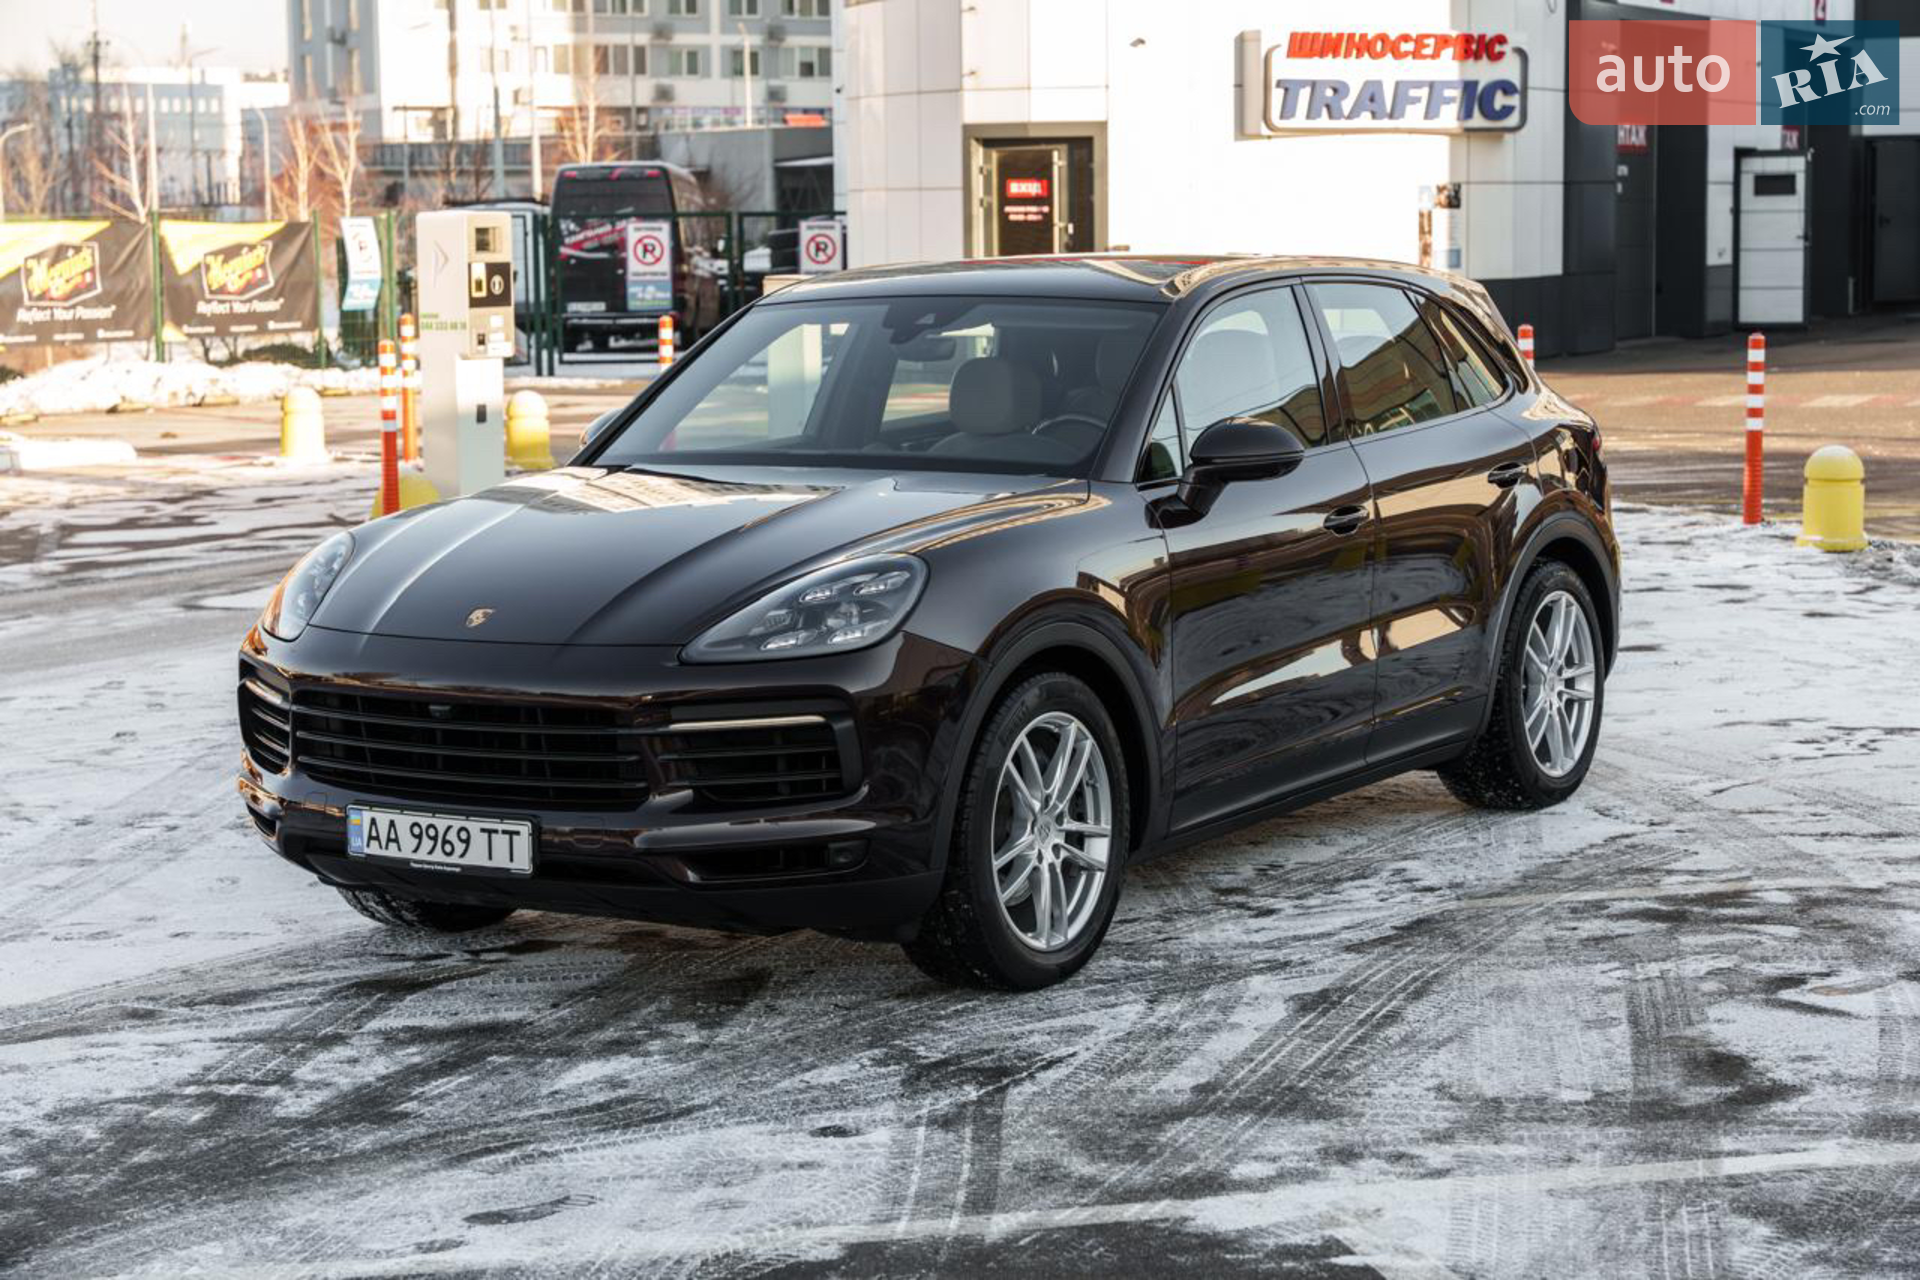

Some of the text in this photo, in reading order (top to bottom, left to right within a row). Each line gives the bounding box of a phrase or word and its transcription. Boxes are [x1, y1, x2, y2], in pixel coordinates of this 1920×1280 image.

[1287, 32, 1508, 62] ШИНОСЕРВІС
[1275, 79, 1519, 121] TRAFFIC
[366, 816, 521, 863] AA 9969 TT
